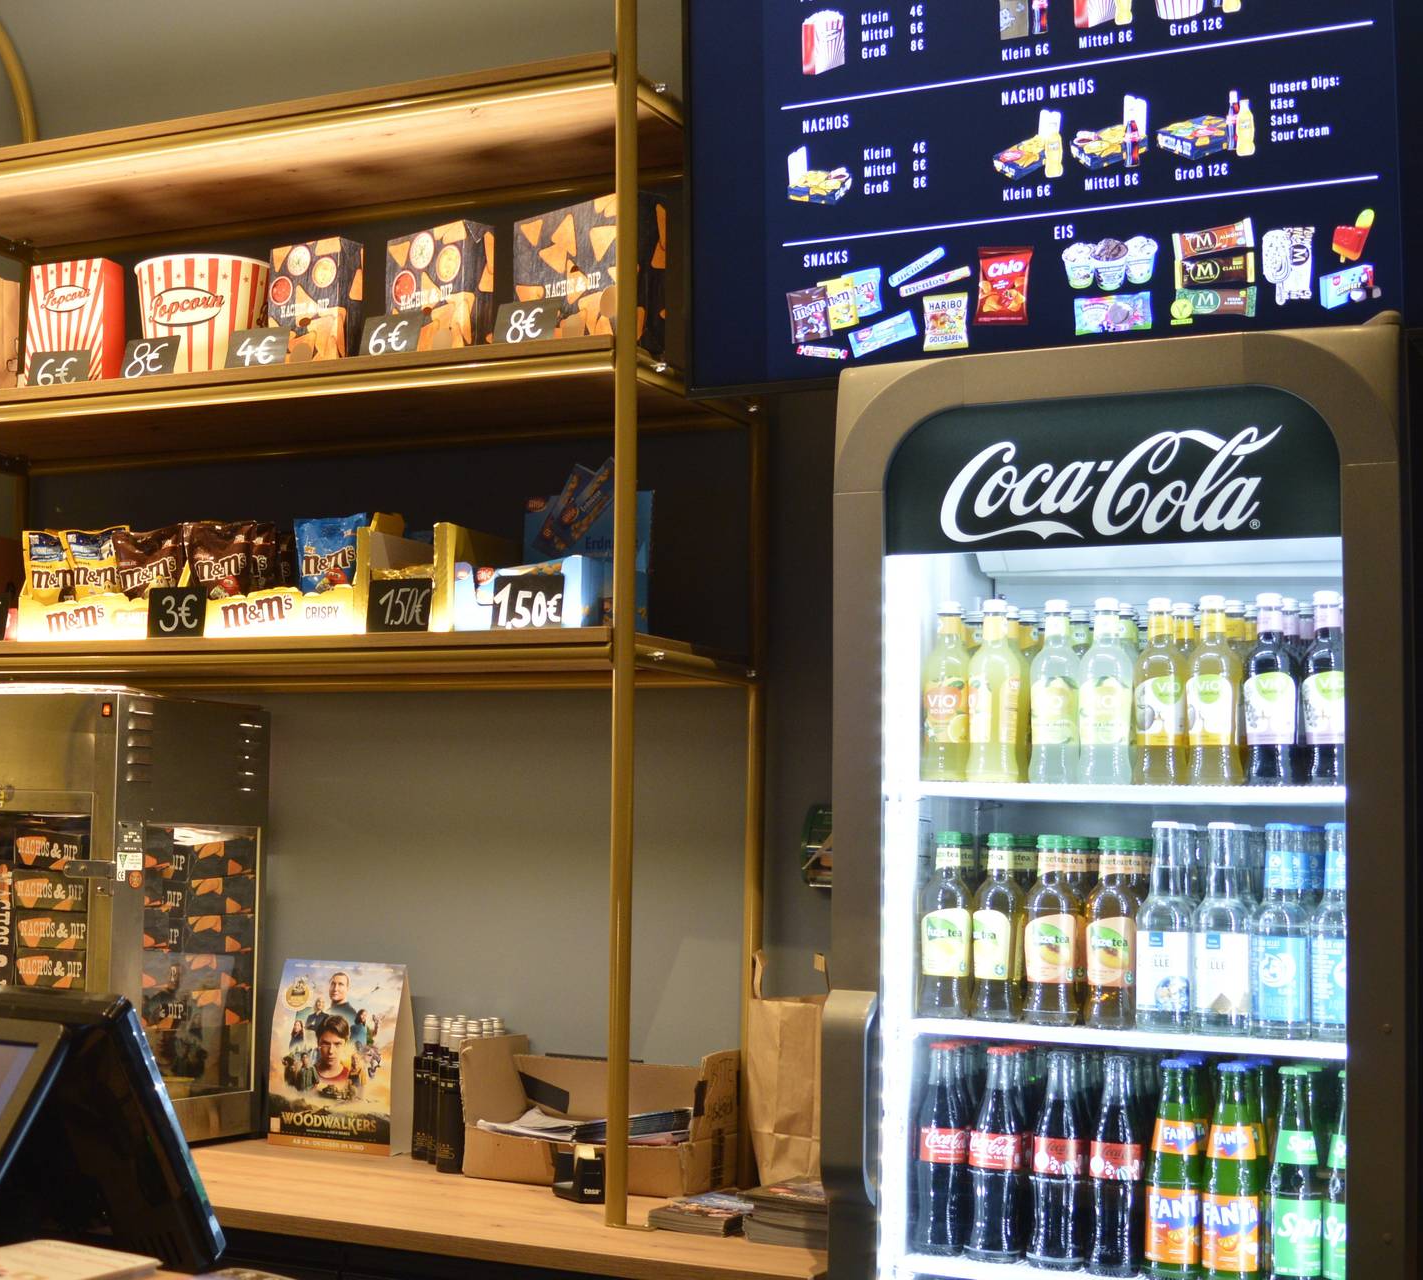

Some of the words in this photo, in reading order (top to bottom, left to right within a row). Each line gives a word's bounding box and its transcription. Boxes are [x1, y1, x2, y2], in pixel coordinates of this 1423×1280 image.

[861, 11, 889, 26] Klein
[909, 5, 923, 17] 4€
[861, 26, 894, 43] Mittel
[910, 22, 924, 35] 6€
[1169, 21, 1198, 37] Groß
[1202, 17, 1223, 32] 12€
[861, 44, 887, 60] Groß
[910, 39, 924, 52] 8€
[1078, 33, 1114, 50] Mittel
[1117, 30, 1133, 44] 8€
[1001, 47, 1031, 62] Klein
[1035, 43, 1050, 56] 6€
[1001, 85, 1044, 106] NACHO
[1049, 78, 1095, 100] MENÜS
[1269, 79, 1309, 95] Unsere
[1311, 75, 1341, 91] Dips:
[1270, 98, 1295, 111] Käse
[802, 114, 850, 134] NACHOS
[1270, 113, 1299, 127] Salsa
[1270, 129, 1295, 143] Sour
[1297, 125, 1330, 140] Cream
[863, 147, 892, 162] Klein
[912, 141, 926, 155] 4€
[863, 162, 896, 179] Mittel
[913, 159, 927, 172] 6€
[1174, 166, 1203, 182] Groß
[1207, 163, 1228, 178] 12€
[863, 180, 889, 196] Groß
[913, 176, 927, 189] 8€
[1002, 187, 1032, 202] Klein
[1036, 184, 1051, 198] 6€
[1084, 175, 1120, 192] Mittel
[1124, 173, 1139, 187] 8€
[1054, 224, 1074, 240] EIS
[803, 250, 848, 268] SNACKS
[988, 259, 1024, 278] Chio
[440, 284, 453, 301] DIP
[545, 280, 576, 299] NACHOS
[588, 271, 602, 290] DIP
[904, 277, 945, 294] mentos
[40, 285, 91, 312] Popcorn
[150, 290, 225, 323] Popcorn
[928, 299, 963, 310] HARIBO
[505, 307, 544, 344] 8€
[368, 320, 409, 356] 6€
[124, 342, 169, 378] 8€
[235, 334, 277, 367] 4€
[37, 358, 77, 387] 6€
[940, 424, 1283, 543] Coca-Cola
[32, 569, 74, 588] m&m
[119, 556, 177, 592] m&m's
[46, 605, 105, 633] m&m's
[158, 593, 199, 633] 3€
[222, 594, 293, 629] m&m's
[305, 606, 339, 620] CRISPY
[17, 837, 50, 857] NACHOS
[50, 843, 62, 859] &
[62, 844, 79, 861] DIP
[15, 881, 52, 901] NACHOS
[52, 884, 66, 902] &
[67, 882, 85, 901] DIP
[167, 891, 183, 908] DIP
[19, 919, 56, 939] NACHOS
[56, 921, 70, 940] &
[70, 920, 87, 939] DIP
[17, 957, 53, 978] NACHOS
[53, 960, 66, 978] &
[66, 959, 83, 978] DIP
[281, 1112, 378, 1135] WOODWALKERS
[1287, 1135, 1315, 1151] Spri
[584, 1187, 601, 1195] tesa
[1149, 1194, 1198, 1219] FANT
[1278, 1212, 1321, 1243] Spri
